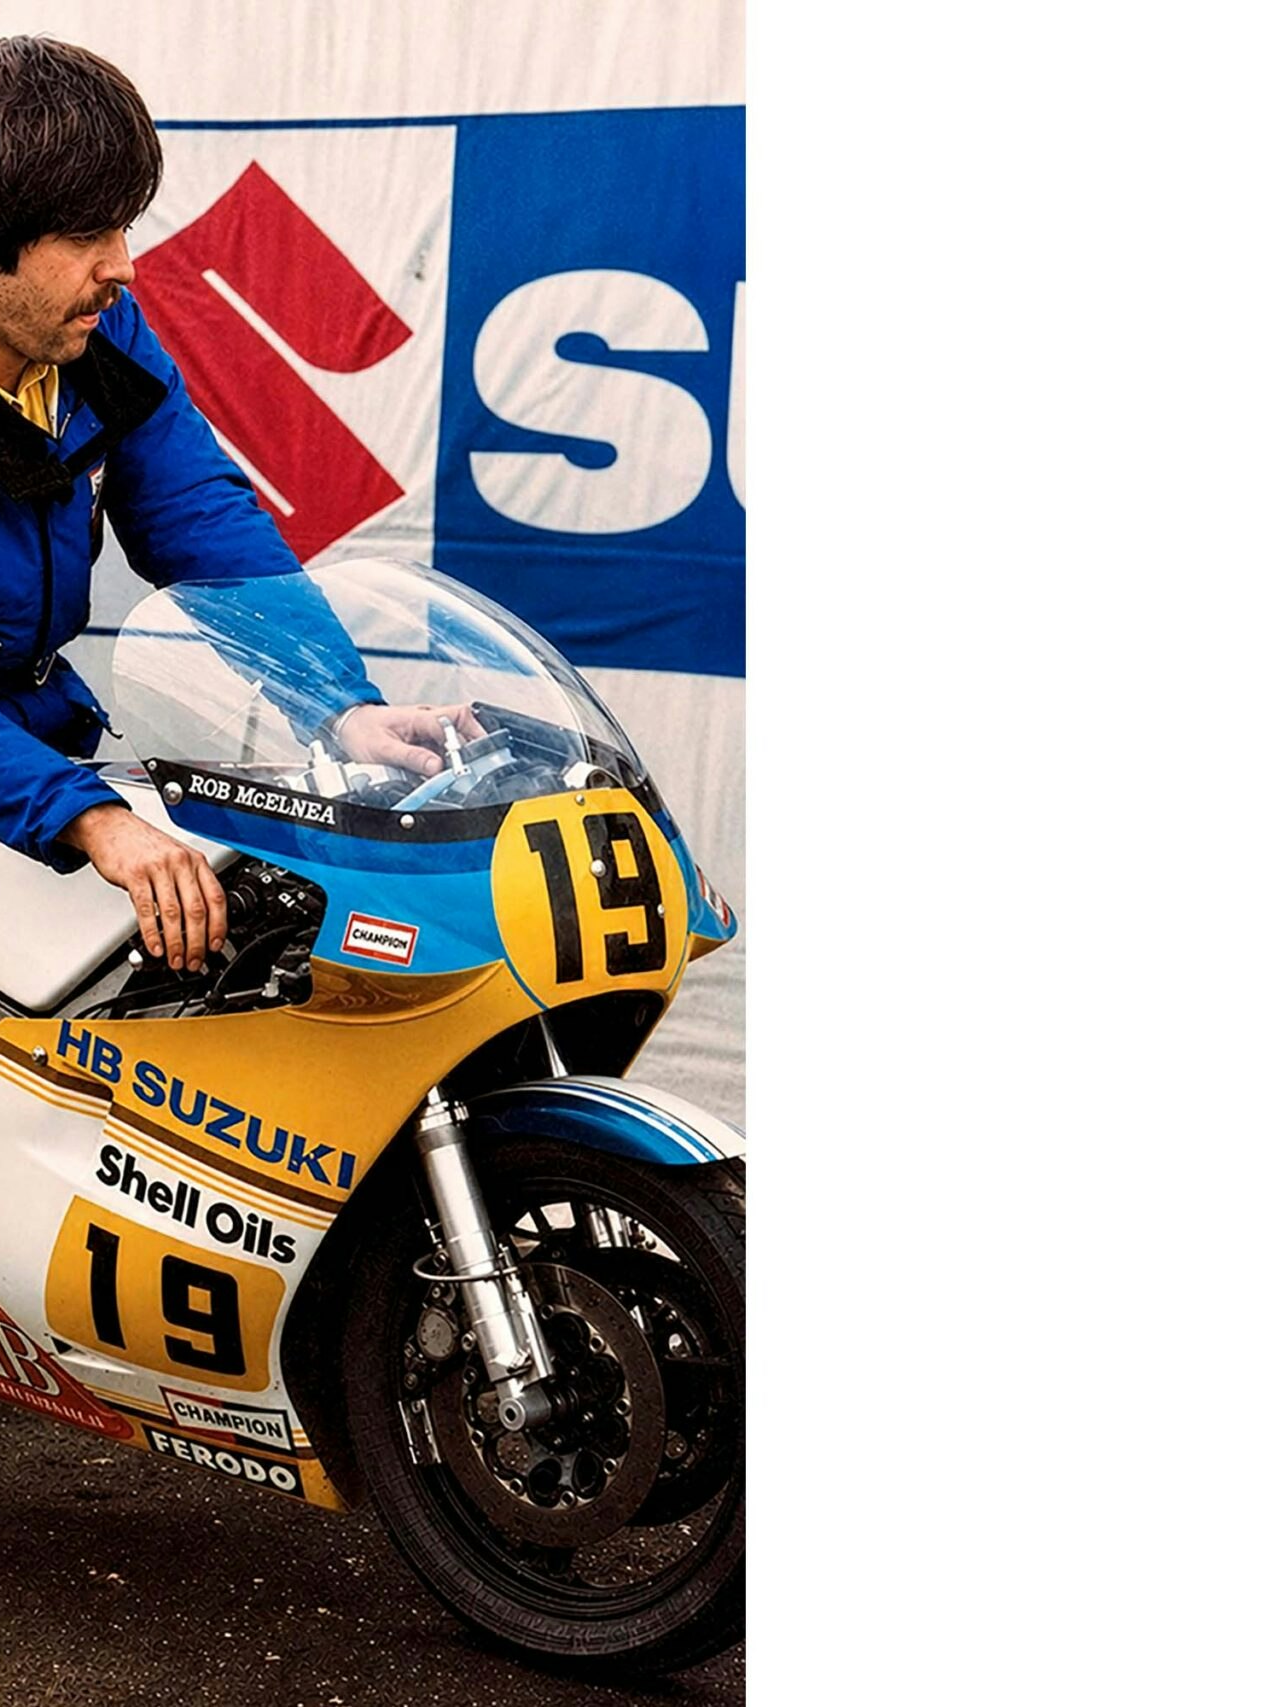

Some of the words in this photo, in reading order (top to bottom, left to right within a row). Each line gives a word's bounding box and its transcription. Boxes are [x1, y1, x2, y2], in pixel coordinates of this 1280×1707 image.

[468, 268, 746, 534] S
[188, 774, 232, 801] ROB
[352, 928, 408, 950] CHAMPION
[523, 812, 667, 984] 19
[56, 1020, 123, 1084] HB
[131, 1060, 357, 1190] SUZUKI
[95, 1144, 202, 1229] Shell
[206, 1202, 297, 1264] Oils
[86, 1222, 247, 1376] 19
[151, 1430, 297, 1491] FERODO
[173, 1402, 284, 1439] CHAMPION
